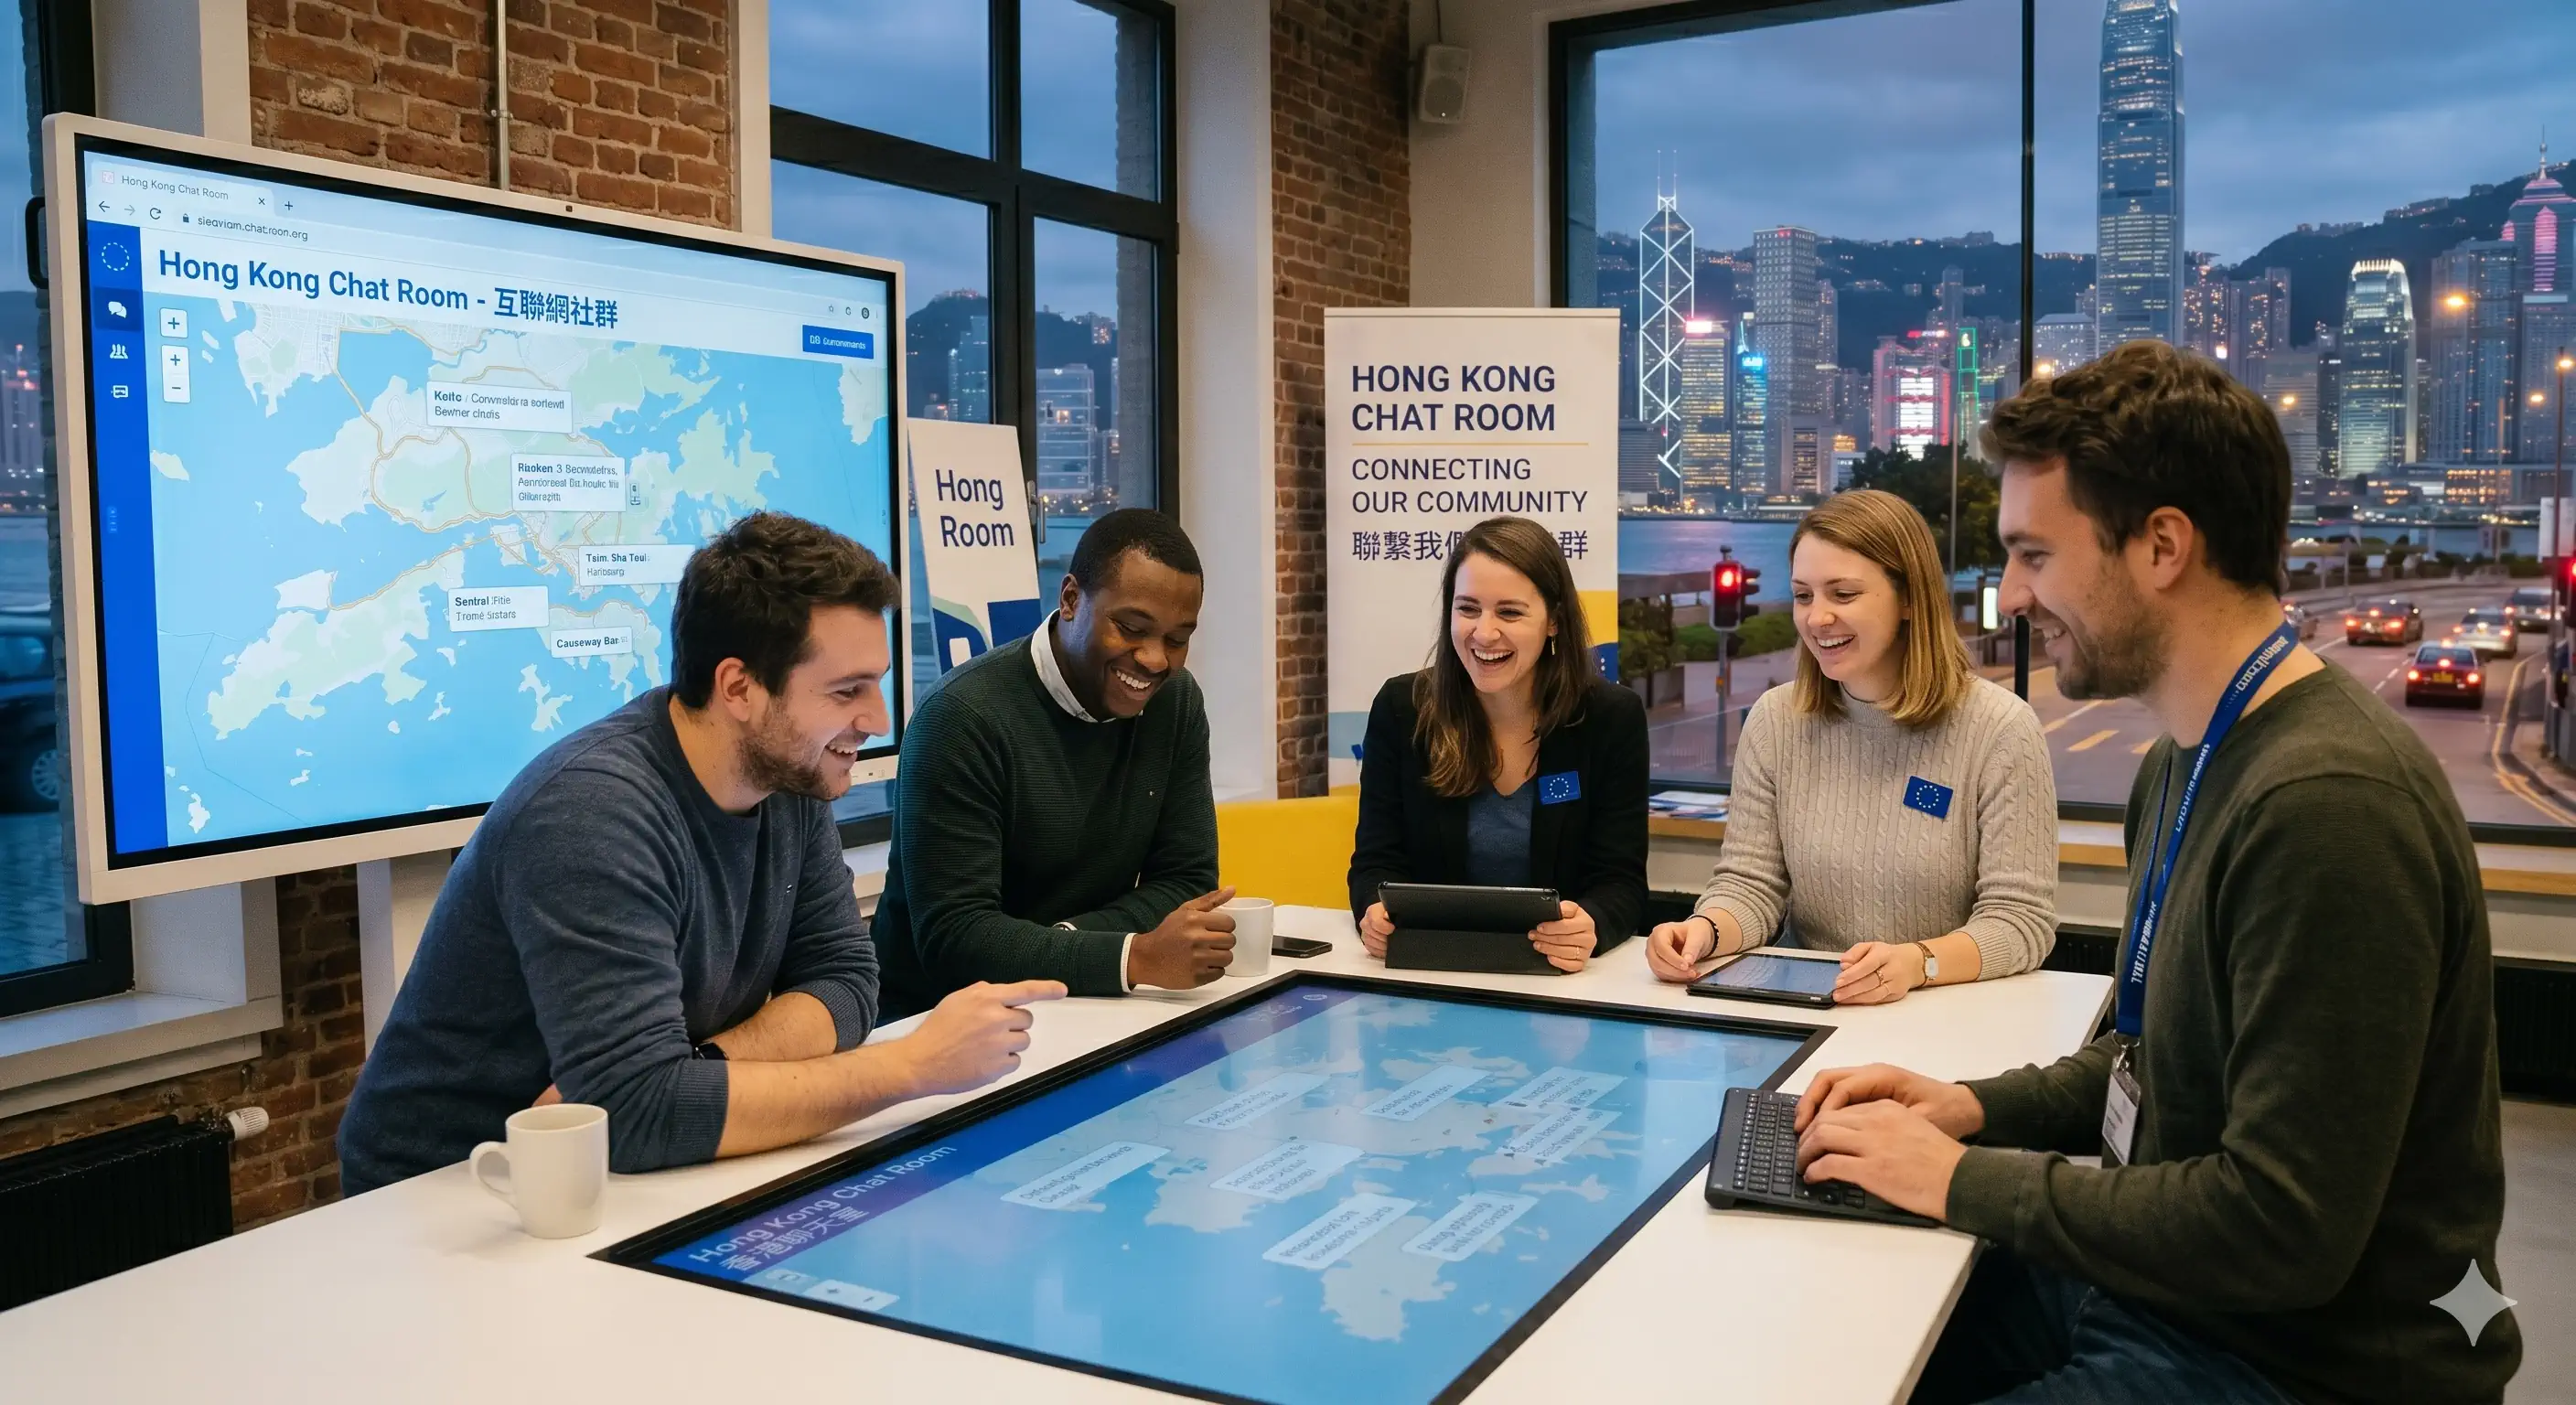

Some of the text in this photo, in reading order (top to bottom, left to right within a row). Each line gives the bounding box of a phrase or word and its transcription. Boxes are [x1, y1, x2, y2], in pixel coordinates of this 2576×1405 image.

[122, 175, 229, 200] Hong Kong Chat Room
[159, 250, 239, 290] Hong
[249, 261, 319, 298] Kong
[329, 271, 389, 301] Chat
[398, 279, 468, 309] Room
[494, 287, 618, 328] 互聯網社群
[1352, 365, 1556, 392] HONG KONG
[1352, 403, 1555, 431] CHAT ROOM
[1352, 458, 1531, 480] CONNECTING
[935, 469, 1004, 511] Hong
[1352, 490, 1588, 513] OUR COMMUNITY
[939, 515, 1014, 548] Room
[611, 553, 627, 563] Sha
[455, 596, 489, 606] Sentral
[556, 638, 601, 649] Causeway
[689, 1145, 958, 1262] Hong Kong Chat Room
